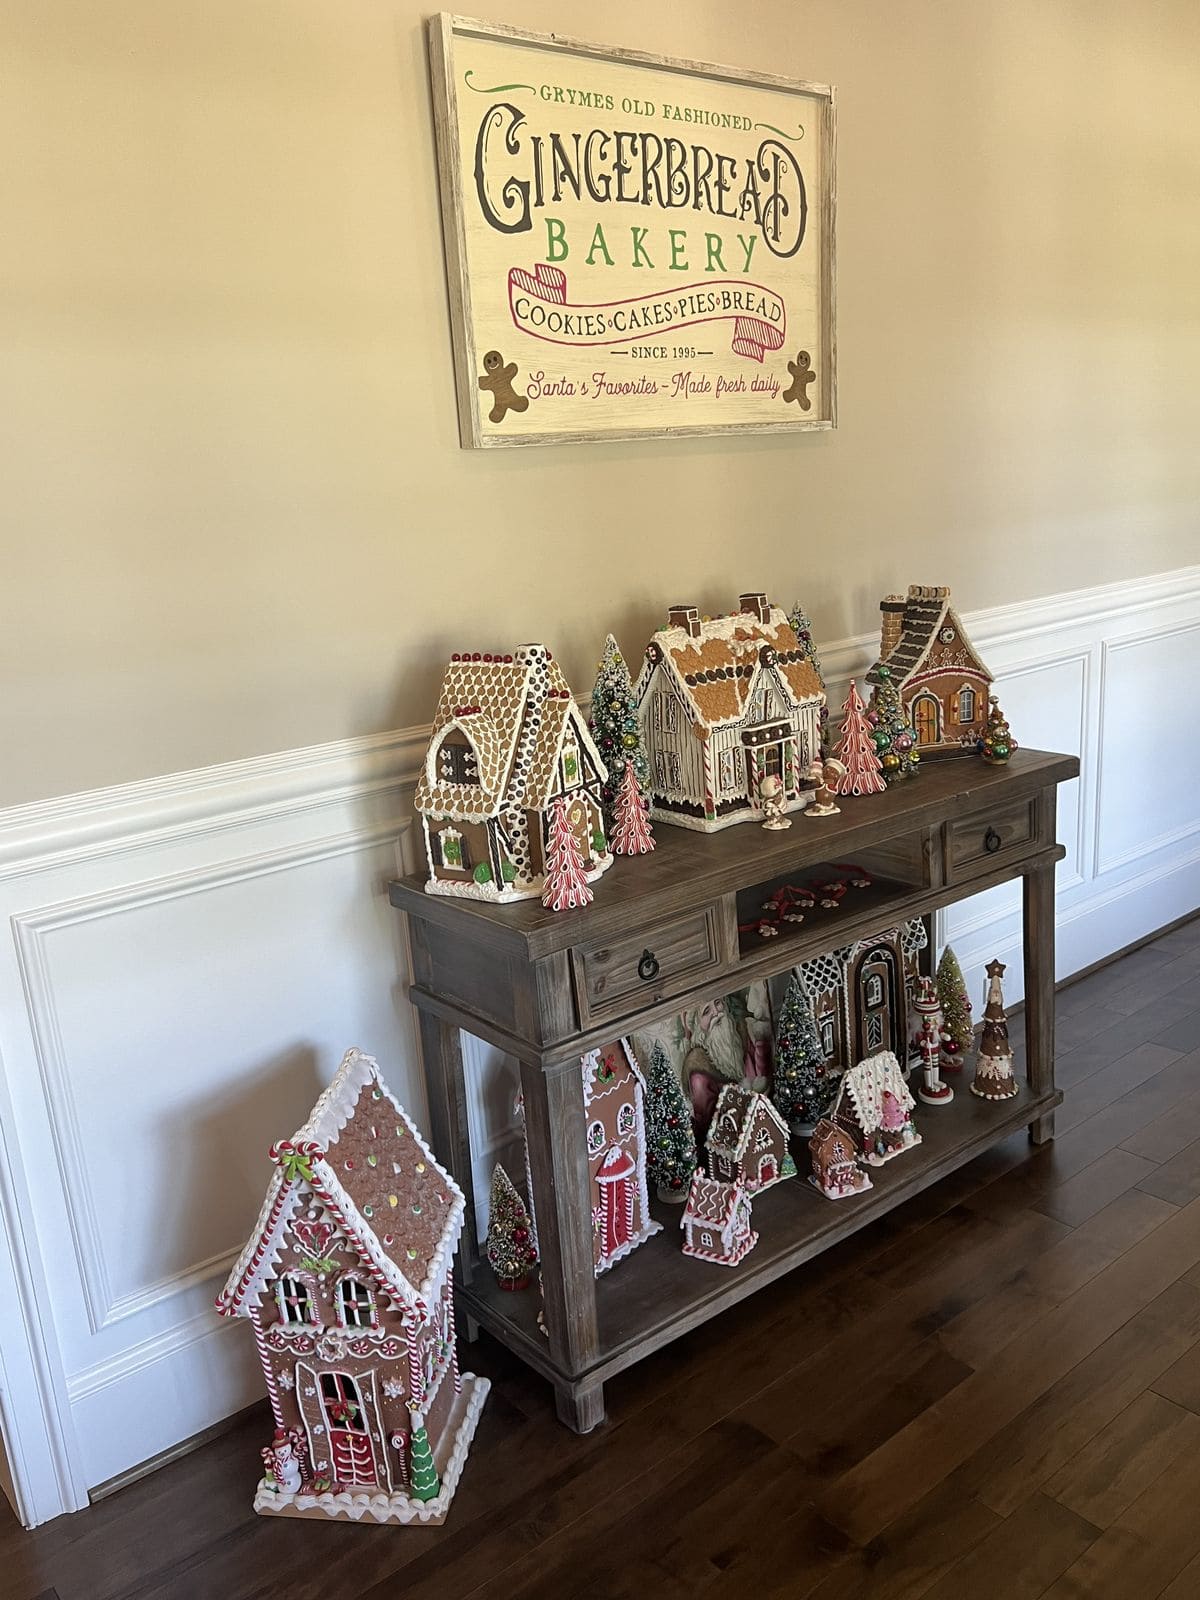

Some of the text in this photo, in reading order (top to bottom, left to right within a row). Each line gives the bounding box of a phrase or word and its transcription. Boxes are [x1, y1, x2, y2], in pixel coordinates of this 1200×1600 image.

[540, 84, 752, 131] GRYMES OLD FASHIONED
[473, 102, 808, 259] GINGERBREAD
[545, 217, 758, 273] BAKERY
[515, 289, 782, 336] COOKIES CAKES PIES BREAD
[631, 346, 697, 359] SINCE 1995
[526, 369, 588, 400] Santa's
[592, 371, 659, 400] Favorites
[671, 371, 711, 399] Made
[715, 374, 747, 398] fresh
[751, 373, 781, 398] daily
